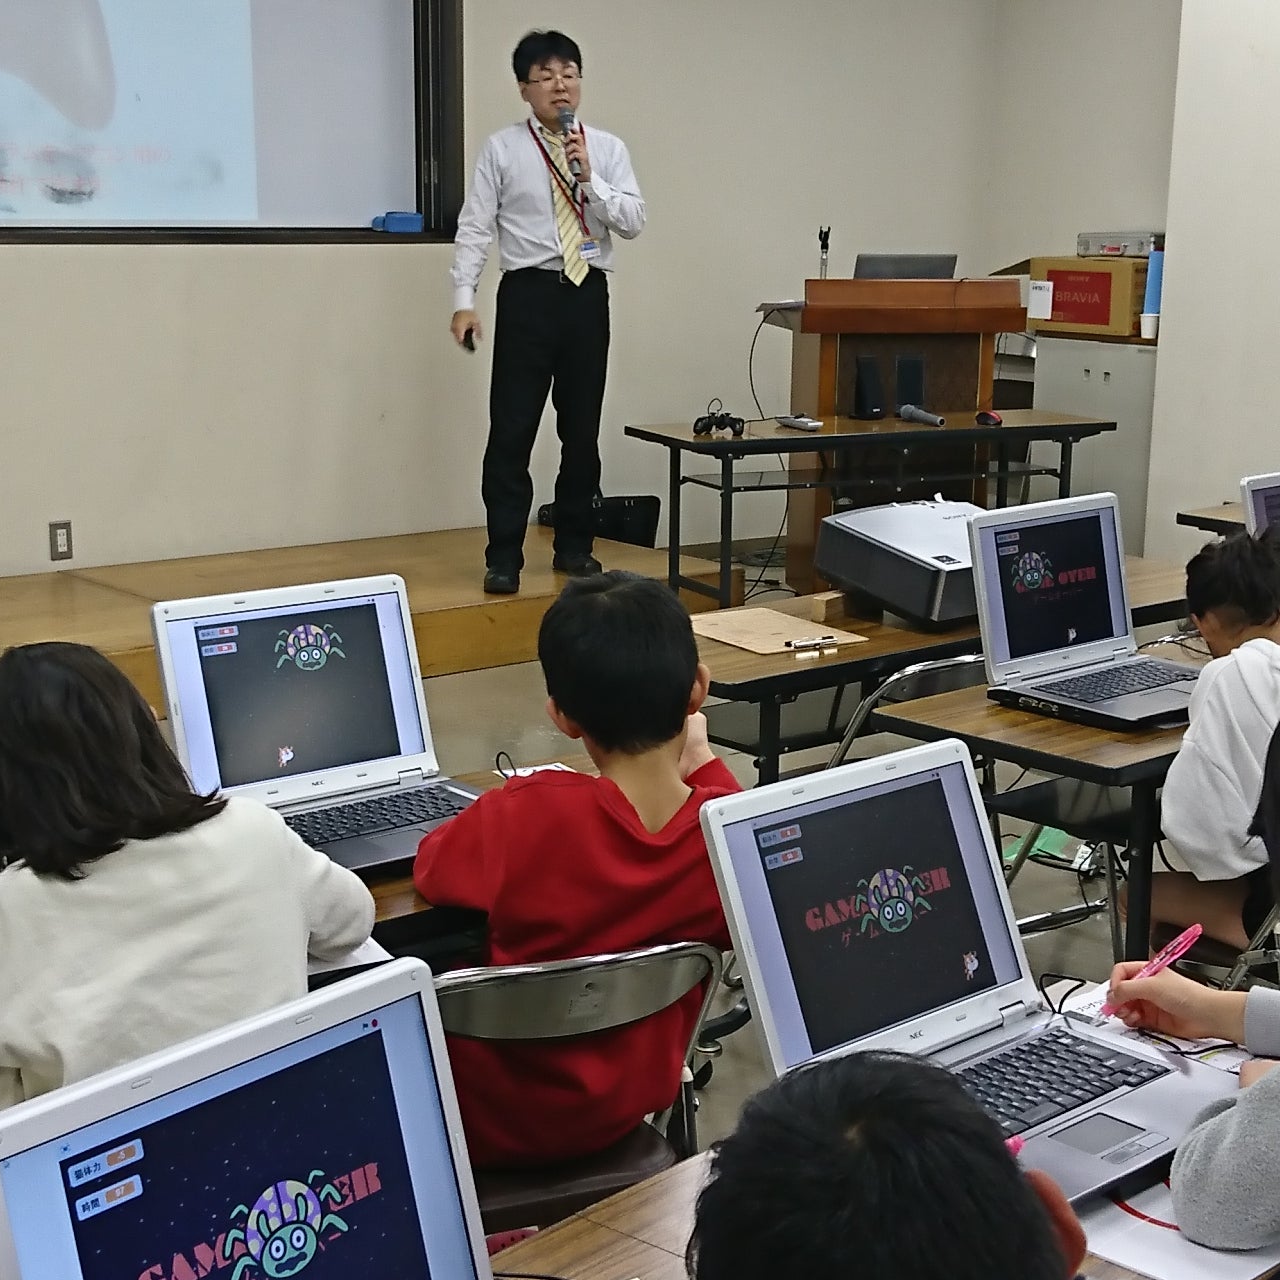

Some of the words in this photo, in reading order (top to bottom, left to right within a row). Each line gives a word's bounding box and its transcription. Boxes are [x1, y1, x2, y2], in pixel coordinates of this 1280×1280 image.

[1055, 291, 1101, 304] BRAVIA
[805, 895, 869, 932] GAM
[81, 1197, 100, 1214] 時間
